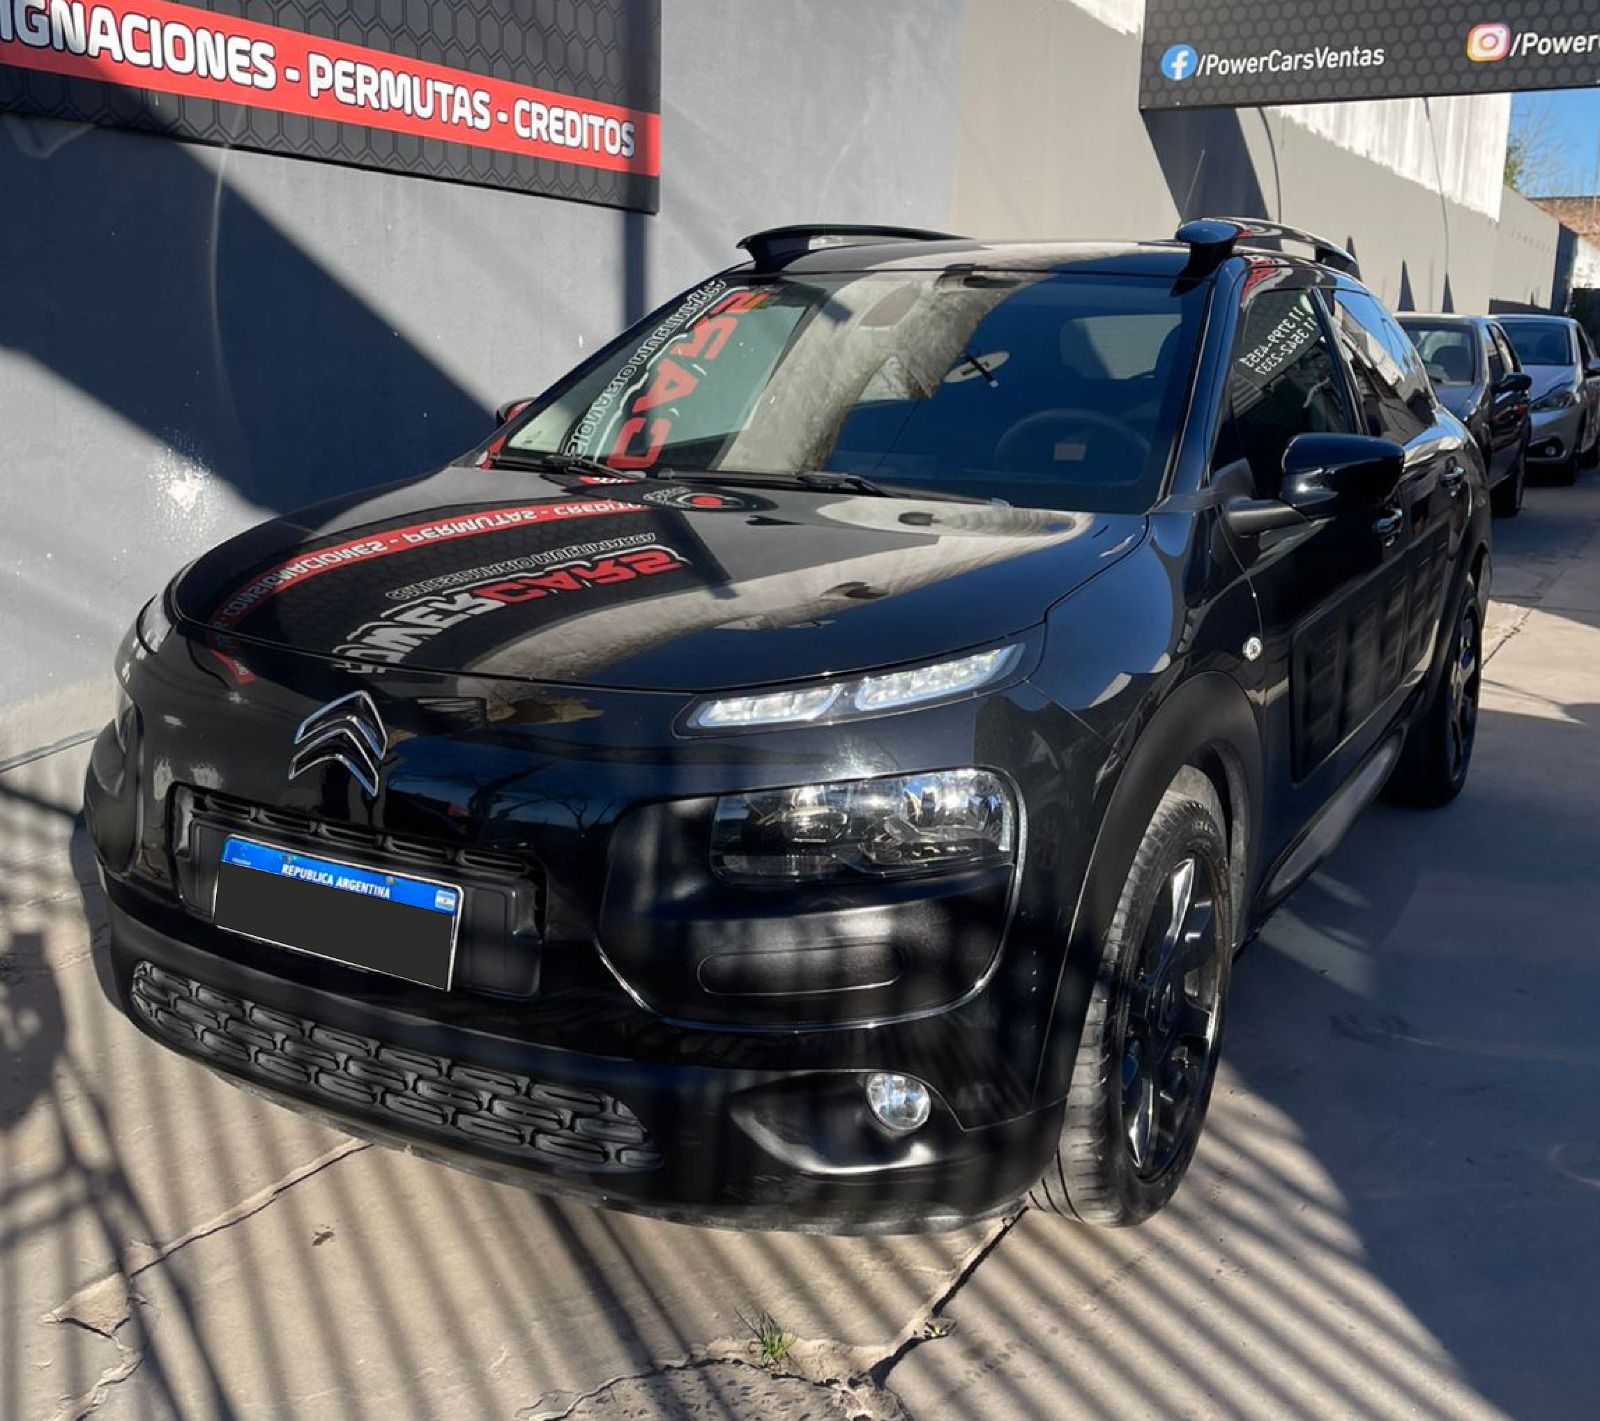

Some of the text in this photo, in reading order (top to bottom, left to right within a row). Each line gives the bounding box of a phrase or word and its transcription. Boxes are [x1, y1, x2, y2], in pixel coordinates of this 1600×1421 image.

[1509, 31, 1600, 57] /Power
[1196, 46, 1385, 77] /PowerCarsVentas
[0, 0, 276, 90] IGNACIONES
[308, 52, 491, 131] PERMUTAS
[513, 99, 636, 159] CREDITOS
[336, 875, 390, 899] ARGENTINA
